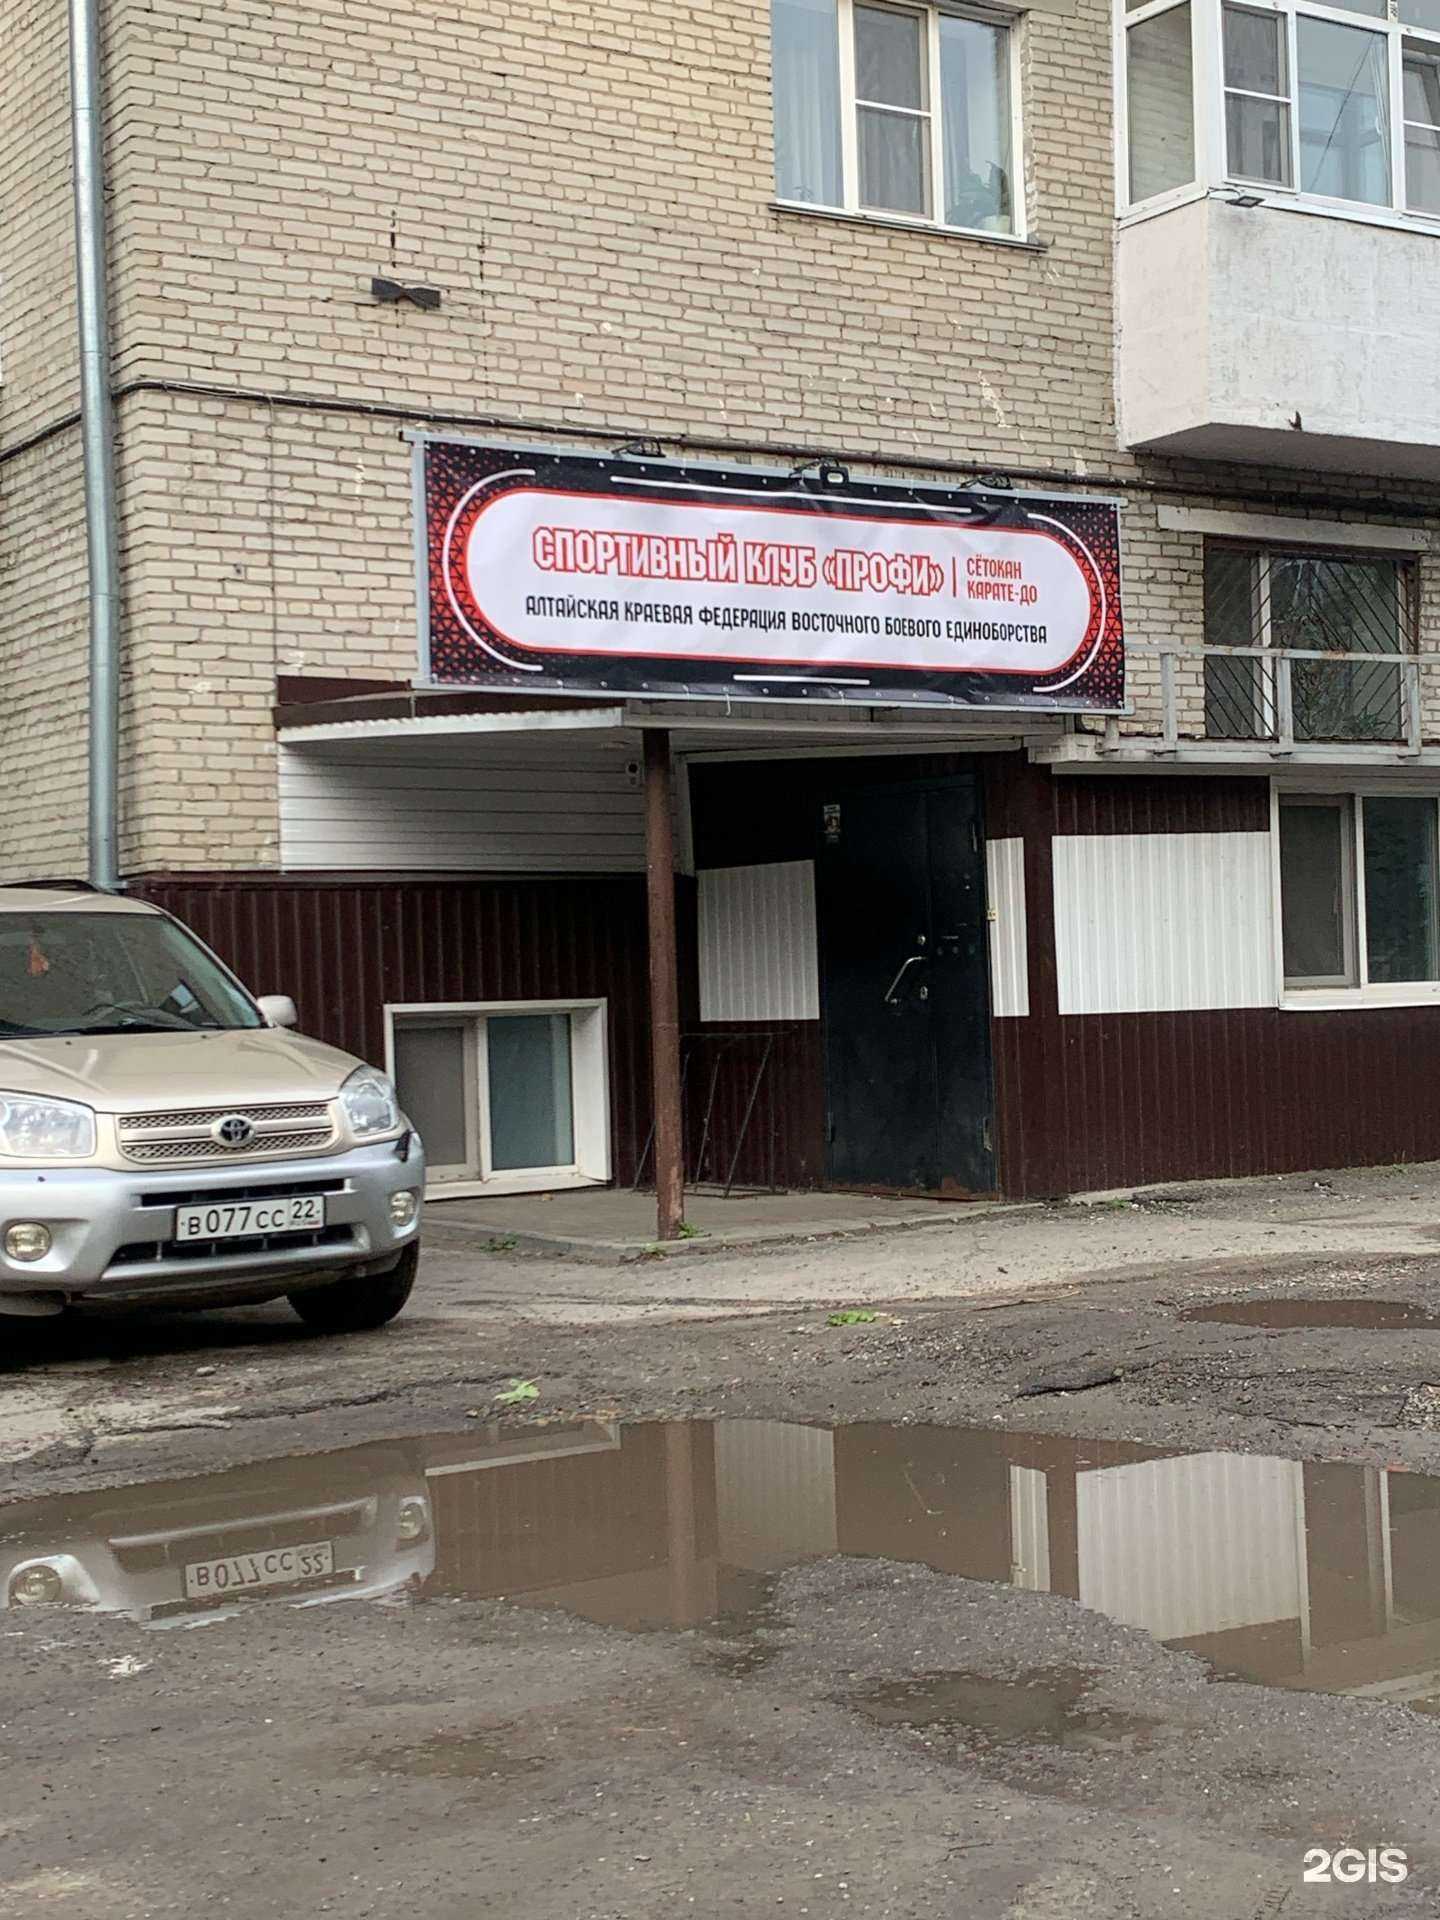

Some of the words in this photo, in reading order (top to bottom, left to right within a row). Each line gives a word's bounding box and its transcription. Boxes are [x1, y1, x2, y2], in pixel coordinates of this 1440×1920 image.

[533, 526, 738, 583] СПОРТИВНЫЙ
[744, 541, 816, 588] КЛУБ
[823, 549, 944, 596] «ПРОФИ»
[966, 554, 1022, 579] СЁТОКАН
[967, 580, 1038, 606] КАРАТЕ-ДО
[526, 595, 619, 620] АЛТАЙСКАЯ
[624, 601, 693, 625] КРАЕВАЯ
[699, 606, 786, 633] ФЕДЕРАЦИЯ
[792, 611, 880, 635] ВОСТОЧНОГО
[885, 617, 941, 639] БОЕВОГО
[946, 621, 1047, 644] ЕДИНОБОРСТВА
